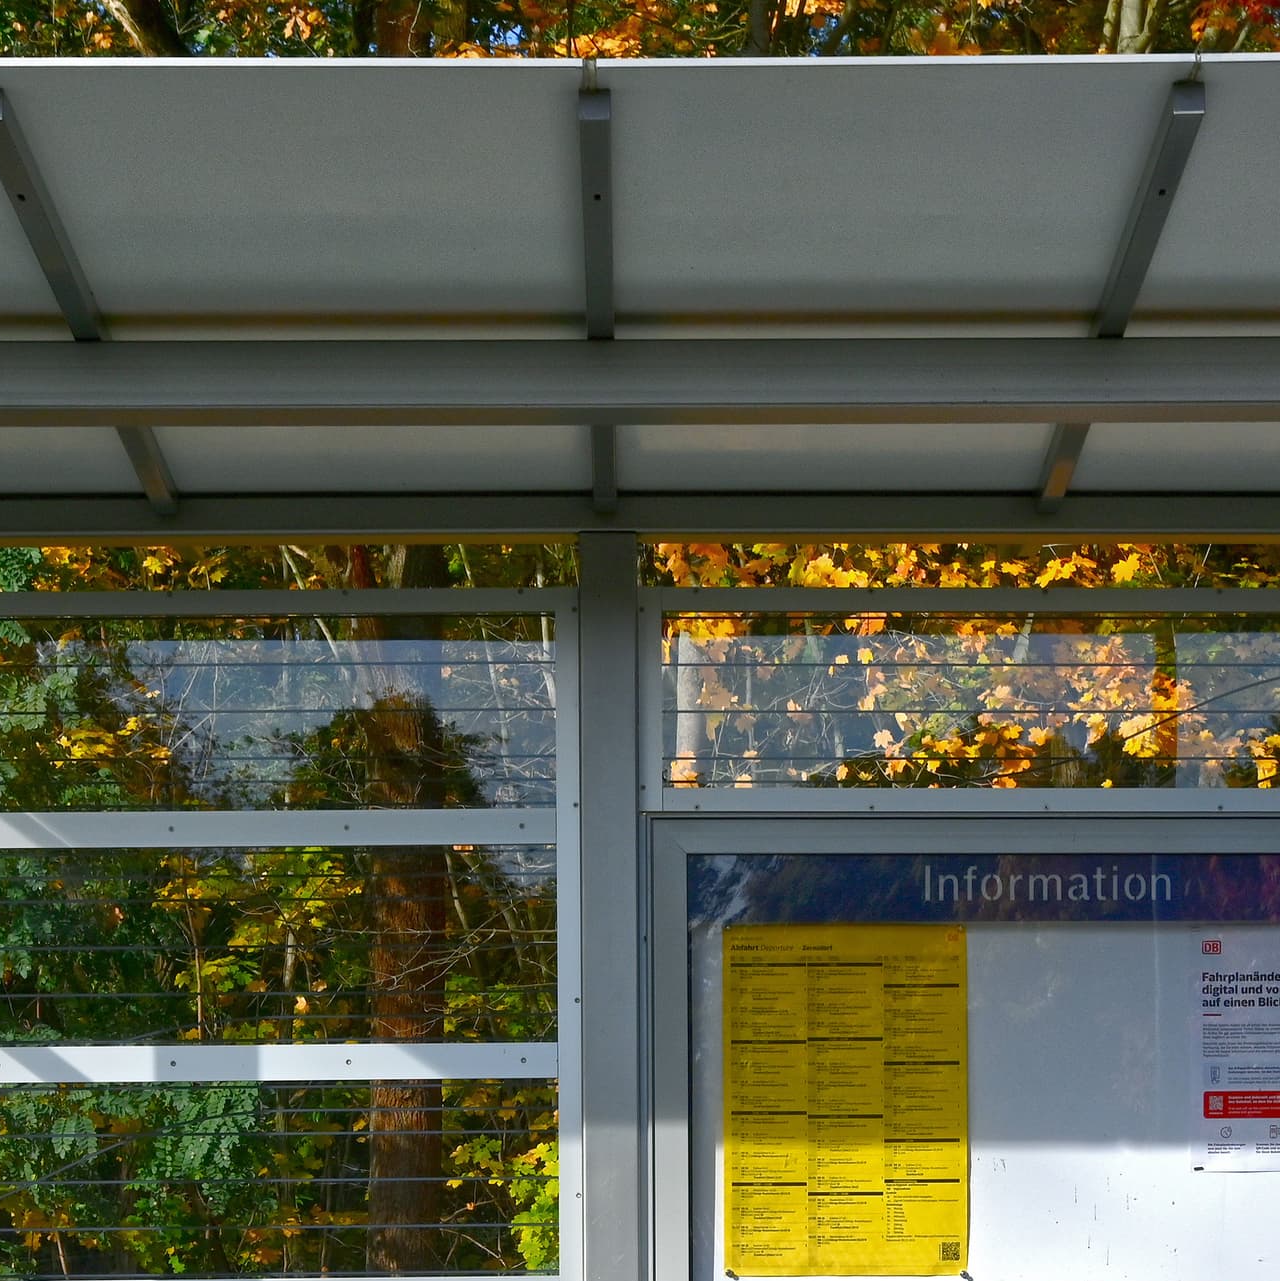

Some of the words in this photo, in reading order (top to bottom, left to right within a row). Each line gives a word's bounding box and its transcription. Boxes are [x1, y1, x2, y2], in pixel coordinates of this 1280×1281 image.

[924, 864, 1172, 901] Information
[1203, 942, 1220, 953] DB
[1202, 985, 1238, 996] digital
[1241, 985, 1263, 994] und
[1202, 998, 1222, 1007] auf
[1224, 998, 1255, 1007] einen
